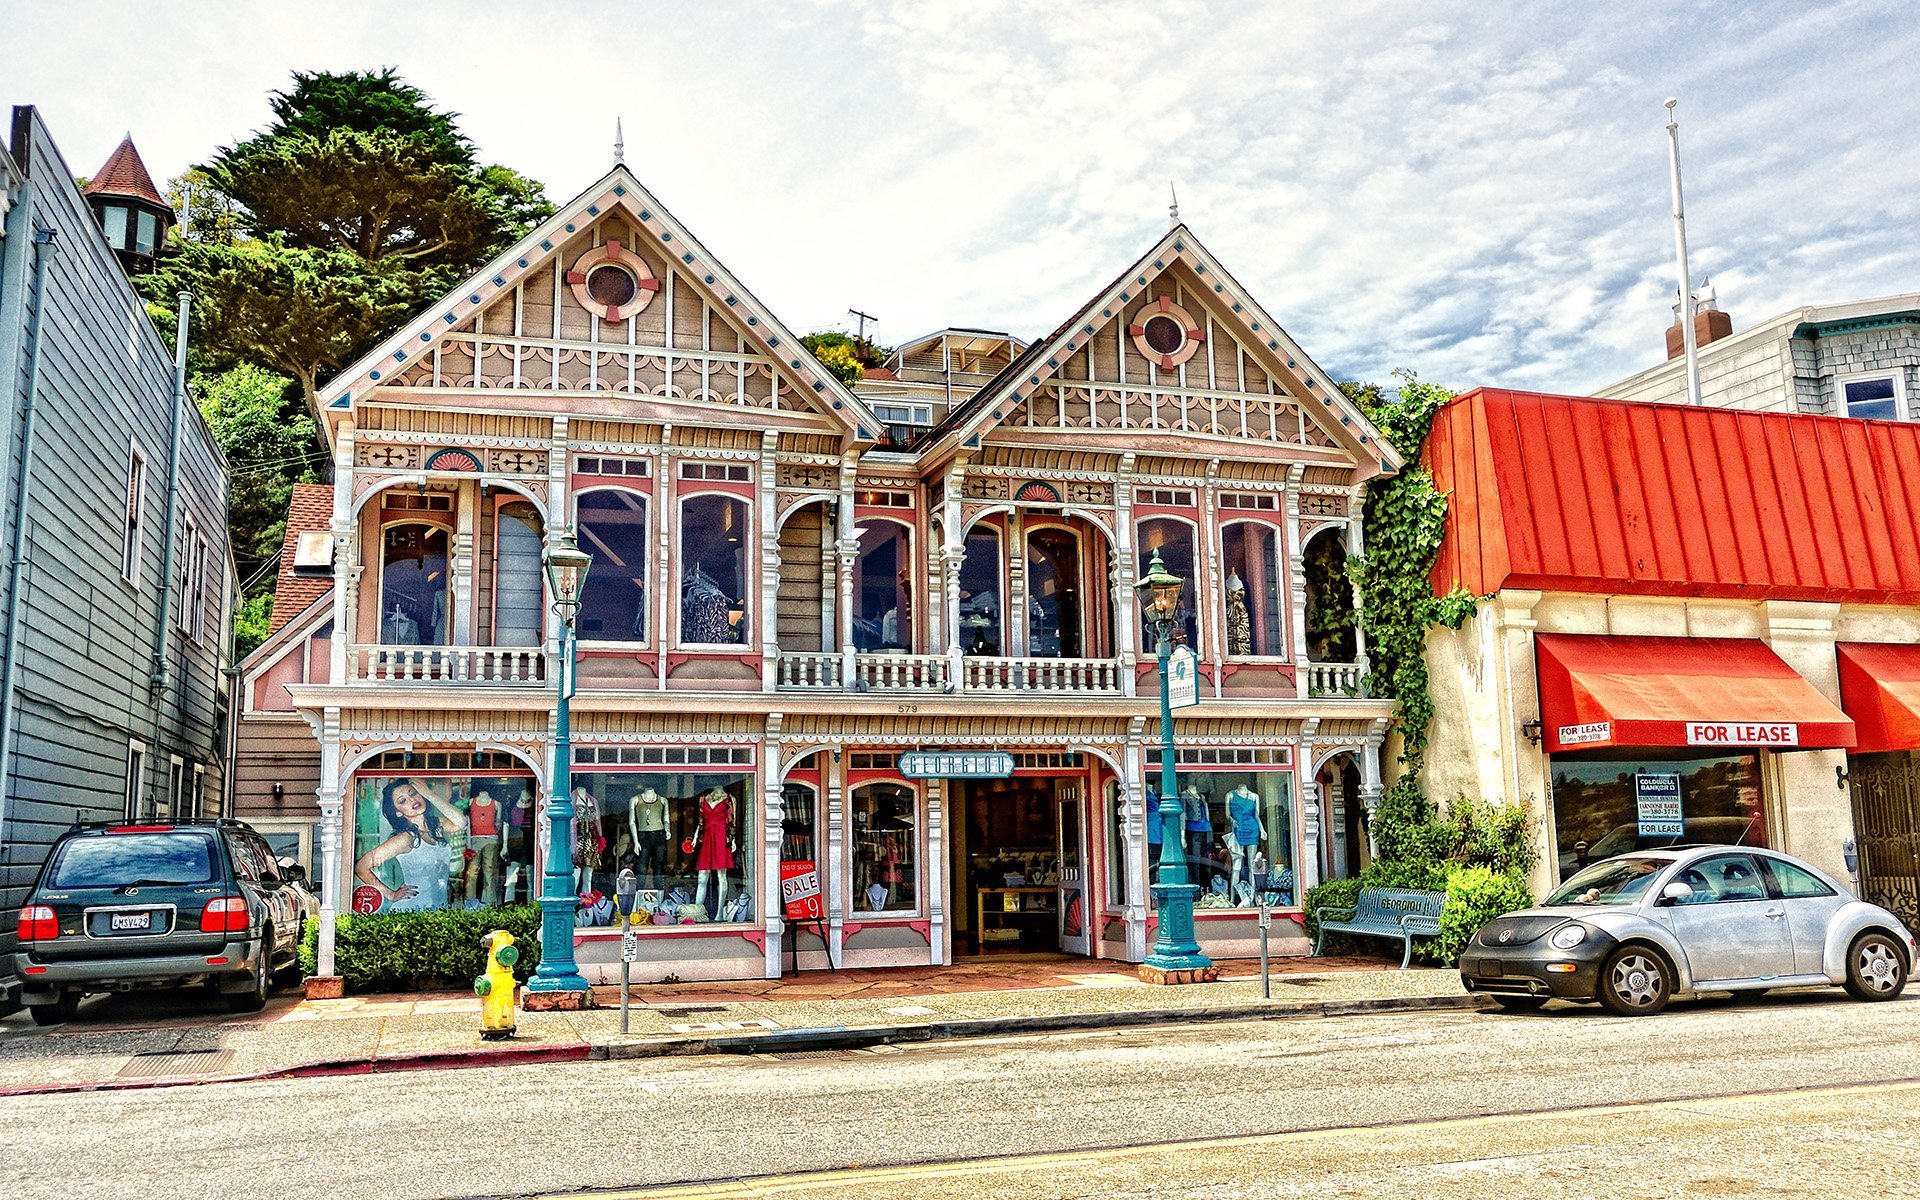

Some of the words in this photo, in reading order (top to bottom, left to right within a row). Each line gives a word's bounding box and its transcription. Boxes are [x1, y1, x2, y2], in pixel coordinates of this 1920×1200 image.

[898, 705, 918, 713] 579
[1561, 727, 1578, 736] FOR
[1581, 723, 1608, 734] LEASE
[1694, 726, 1728, 742] FOR
[1736, 727, 1791, 742] LEASE
[910, 756, 1005, 774] GEORGIOU
[1641, 825, 1656, 833] FOR
[1658, 825, 1681, 833] LEASE
[784, 875, 817, 896] SALE
[1381, 899, 1422, 912] GEORGIOU
[113, 917, 148, 927] 4MSV429
